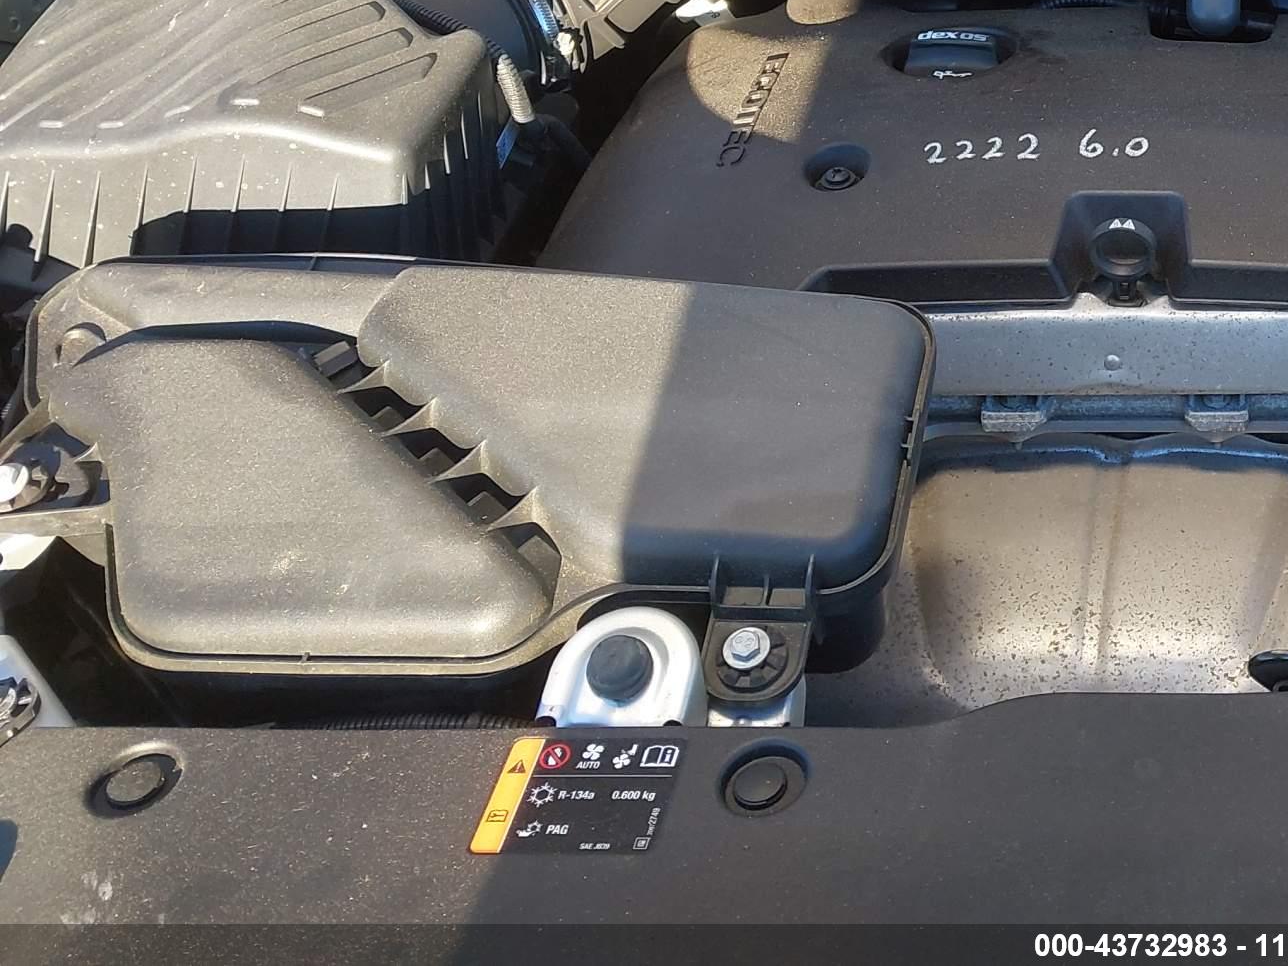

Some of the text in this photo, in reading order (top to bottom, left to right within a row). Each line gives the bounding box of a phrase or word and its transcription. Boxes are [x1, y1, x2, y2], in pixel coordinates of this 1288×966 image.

[917, 30, 989, 42] dexos
[716, 52, 789, 167] ECOTEC
[923, 128, 1150, 164] 2222 6.0
[575, 760, 601, 769] AUTO
[557, 790, 657, 802] R-134a 0.600 kg
[545, 824, 570, 835] PAG
